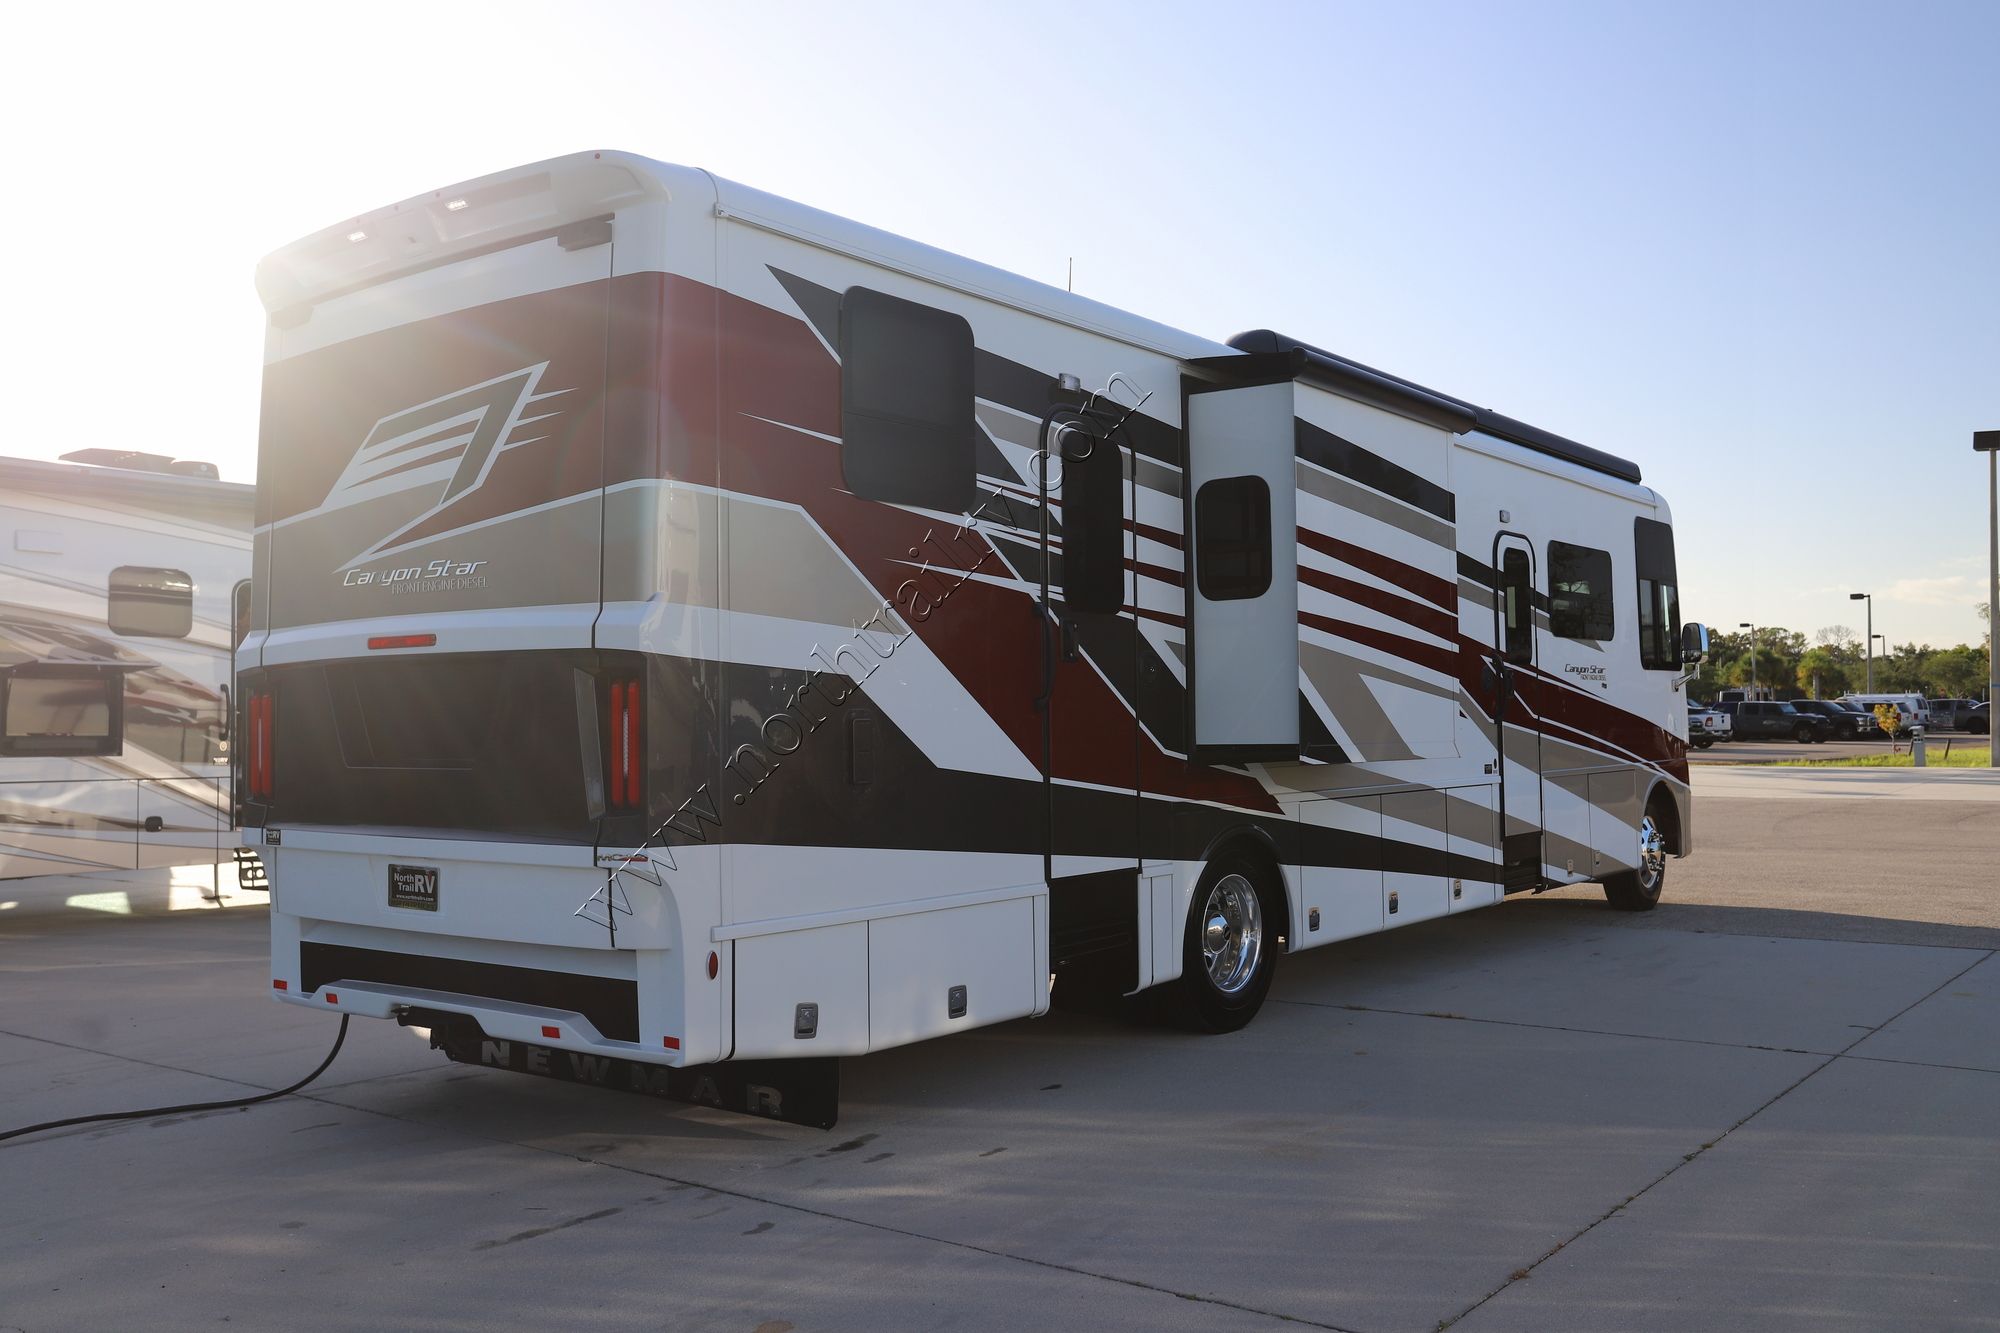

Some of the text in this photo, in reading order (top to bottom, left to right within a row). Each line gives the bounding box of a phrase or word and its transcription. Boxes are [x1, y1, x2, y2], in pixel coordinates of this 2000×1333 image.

[343, 559, 488, 586] Canyon Star
[391, 576, 489, 595] FRONT ENGINE DIESEL
[1564, 664, 1607, 675] Canyon Star
[394, 872, 415, 883] North
[397, 882, 415, 892] Trail
[414, 874, 435, 894] RV
[482, 1039, 783, 1116] NEWMAR
